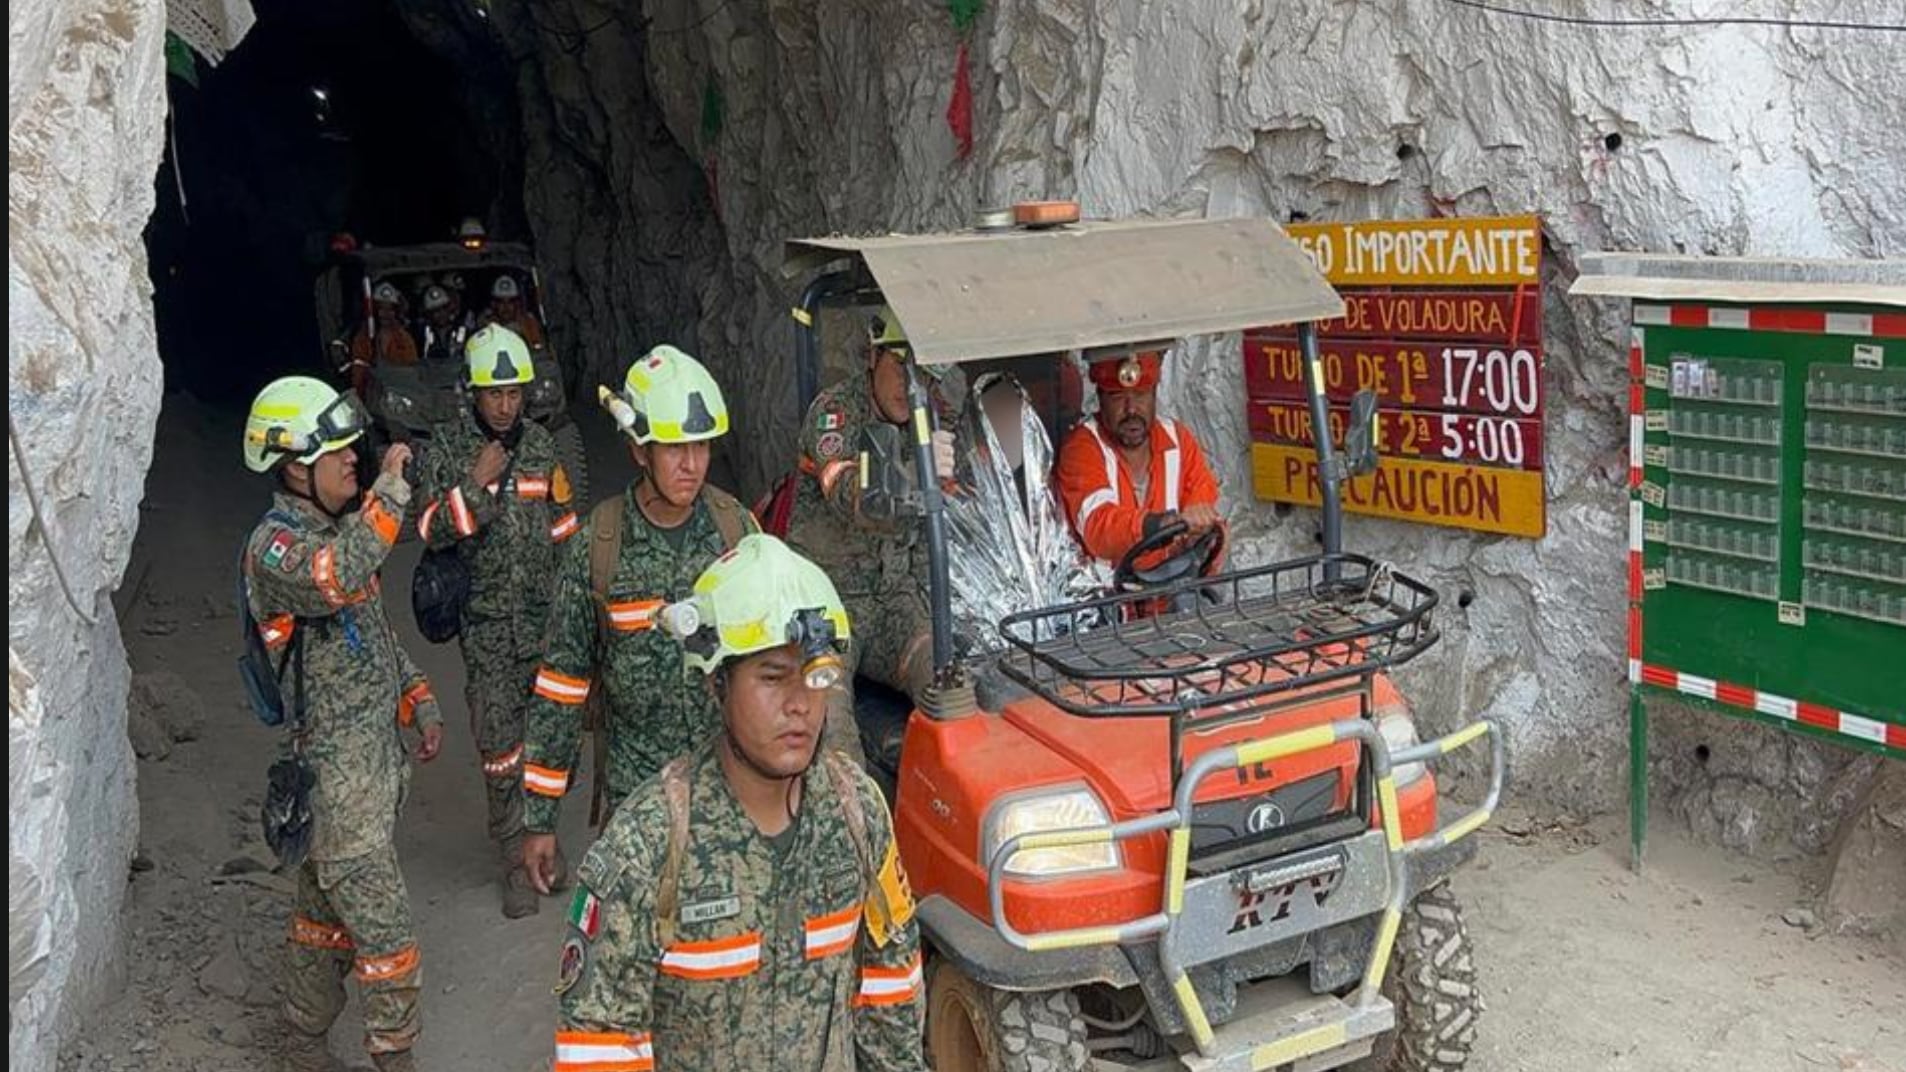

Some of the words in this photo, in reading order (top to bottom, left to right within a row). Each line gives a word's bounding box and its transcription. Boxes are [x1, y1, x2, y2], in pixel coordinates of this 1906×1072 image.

[1344, 226, 1537, 276] IMPORTANTE
[1345, 296, 1372, 331] DE
[1378, 299, 1507, 334] VOLADURA
[1357, 352, 1390, 395] DE
[1441, 348, 1538, 414] 17:00
[1268, 405, 1343, 446] TURO
[1441, 414, 1524, 464] 5:00
[1285, 456, 1501, 524] PRCAUCIÓN
